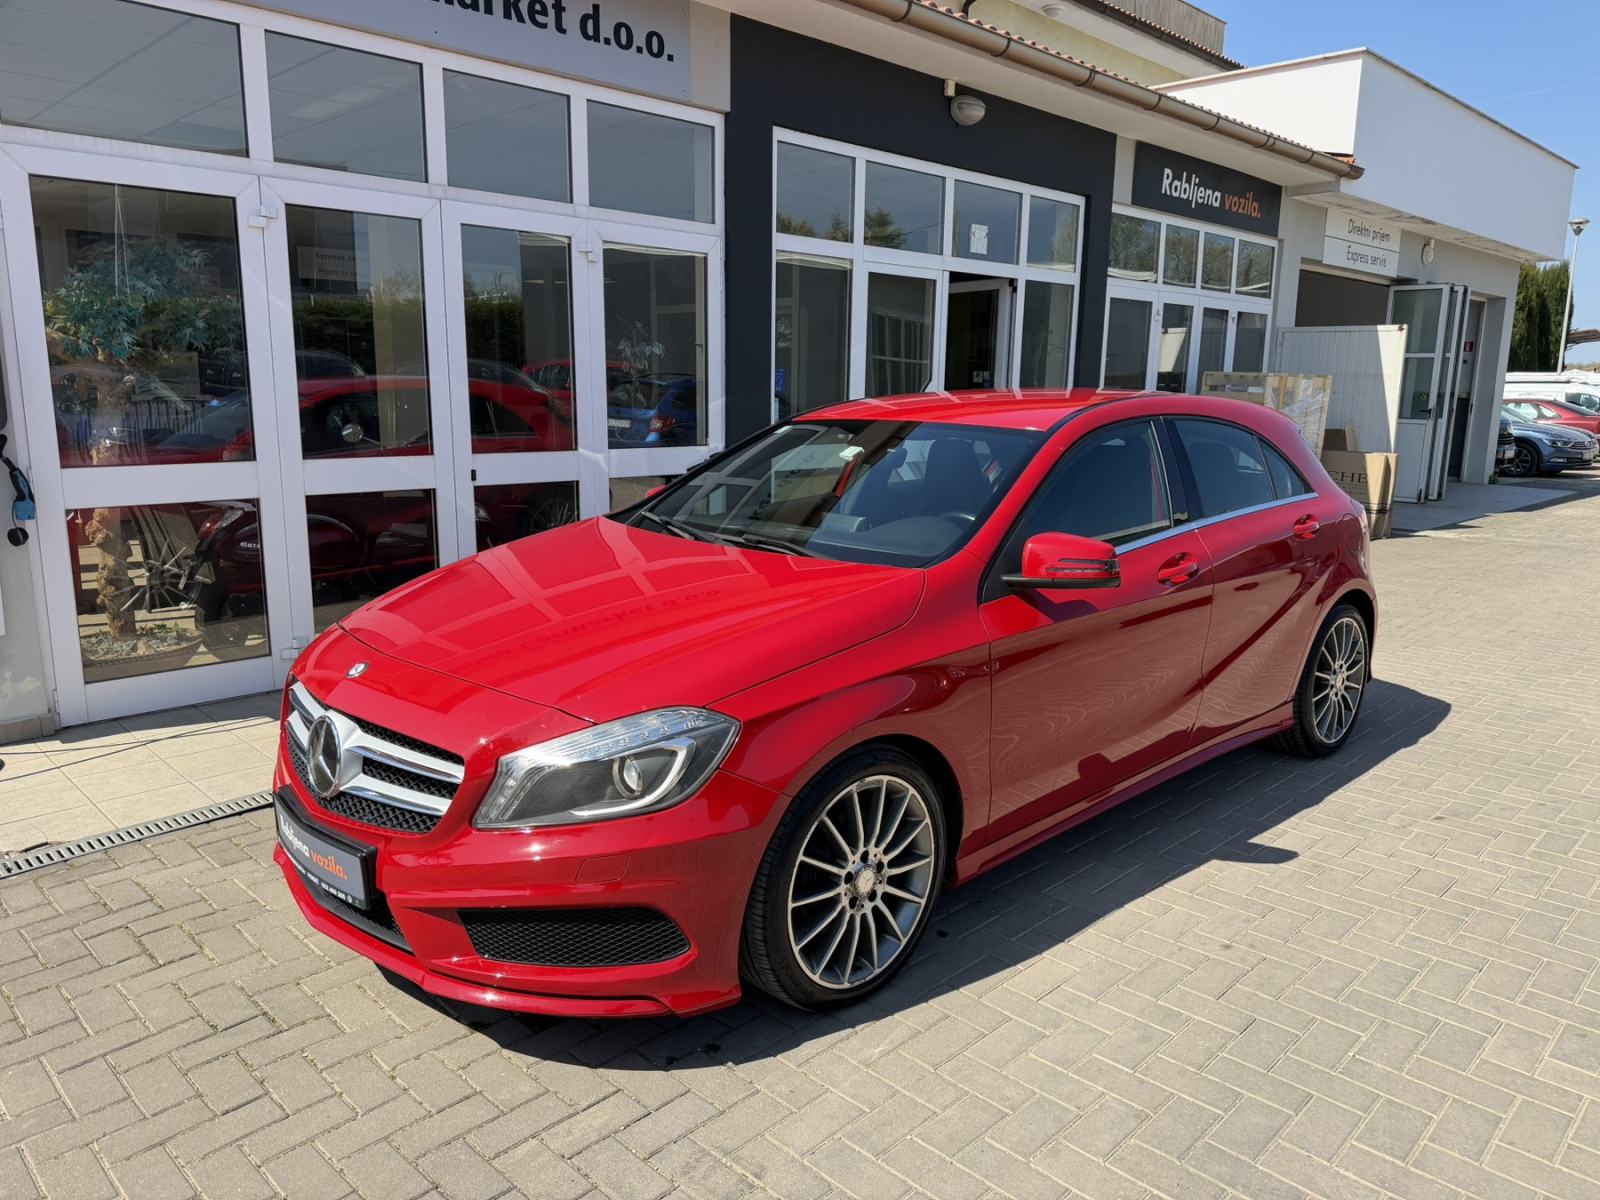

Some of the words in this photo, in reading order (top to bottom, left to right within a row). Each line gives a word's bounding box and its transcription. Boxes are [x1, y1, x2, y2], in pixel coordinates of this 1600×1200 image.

[431, 0, 567, 35] rket
[579, 3, 674, 62] d.o.o.
[1161, 167, 1222, 209] Rabljena
[1224, 191, 1262, 218] vozila.
[1347, 218, 1371, 239] Direktni
[1371, 227, 1391, 244] prijem
[1346, 245, 1369, 265] Express
[1369, 253, 1388, 268] servis
[310, 849, 348, 881] vozila.
